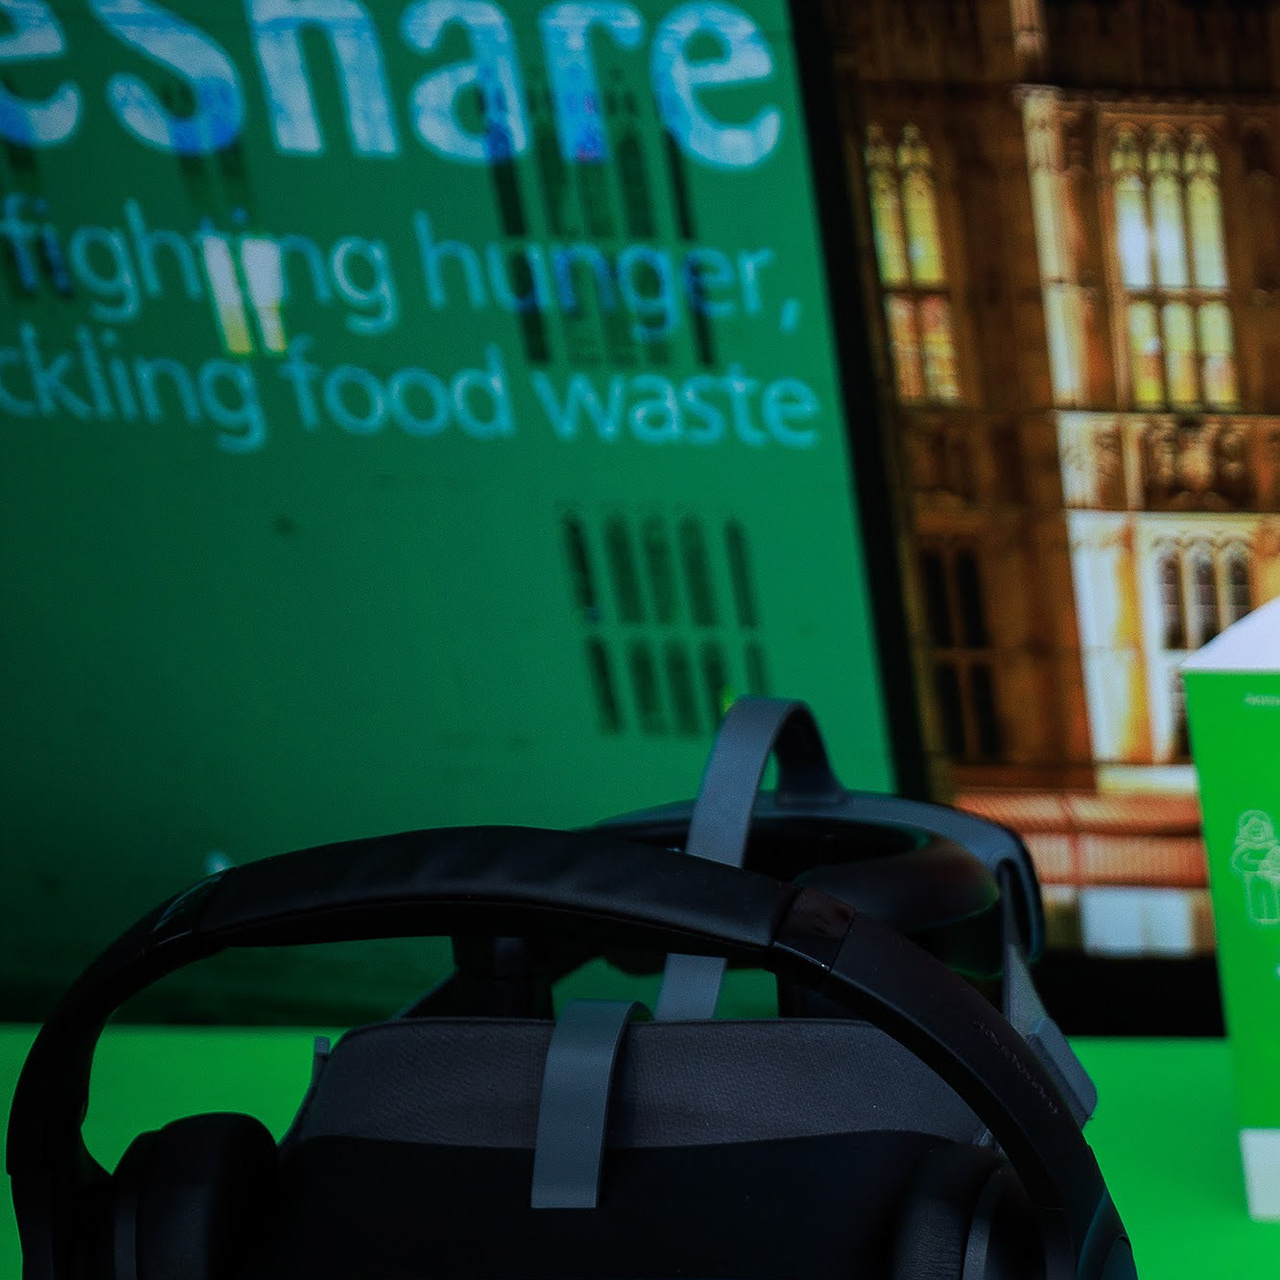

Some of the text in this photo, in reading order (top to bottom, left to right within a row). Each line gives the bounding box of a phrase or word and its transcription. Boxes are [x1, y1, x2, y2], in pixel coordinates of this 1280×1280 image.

[414, 210, 798, 342] hunger,
[281, 335, 517, 439] food
[531, 363, 823, 449] waste
